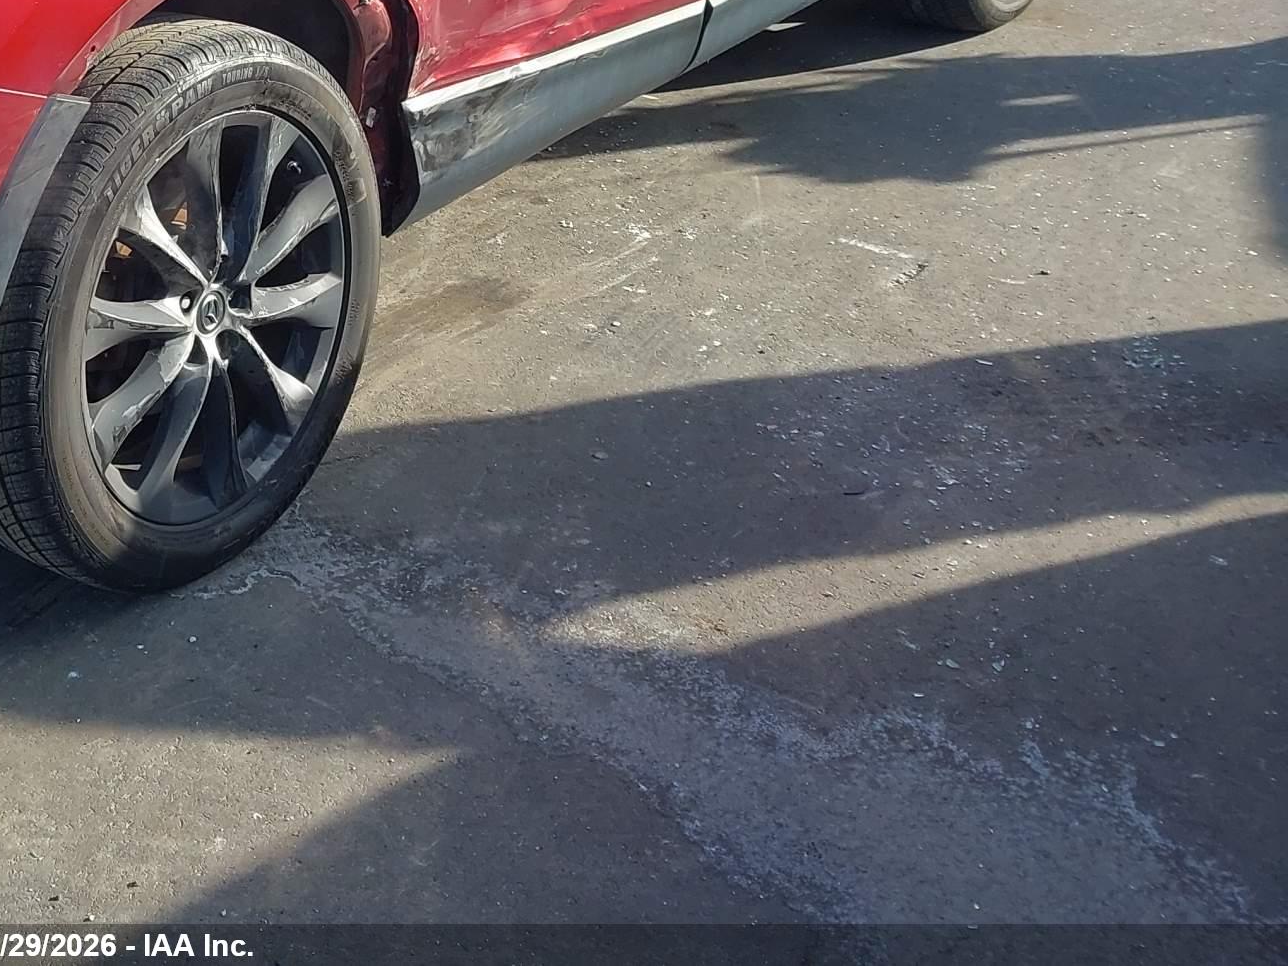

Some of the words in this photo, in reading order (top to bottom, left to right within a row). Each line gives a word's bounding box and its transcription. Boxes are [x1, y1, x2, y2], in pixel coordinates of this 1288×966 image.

[103, 124, 156, 203] TIGER
[171, 77, 213, 119] PAW
[222, 66, 253, 85] TOURING
